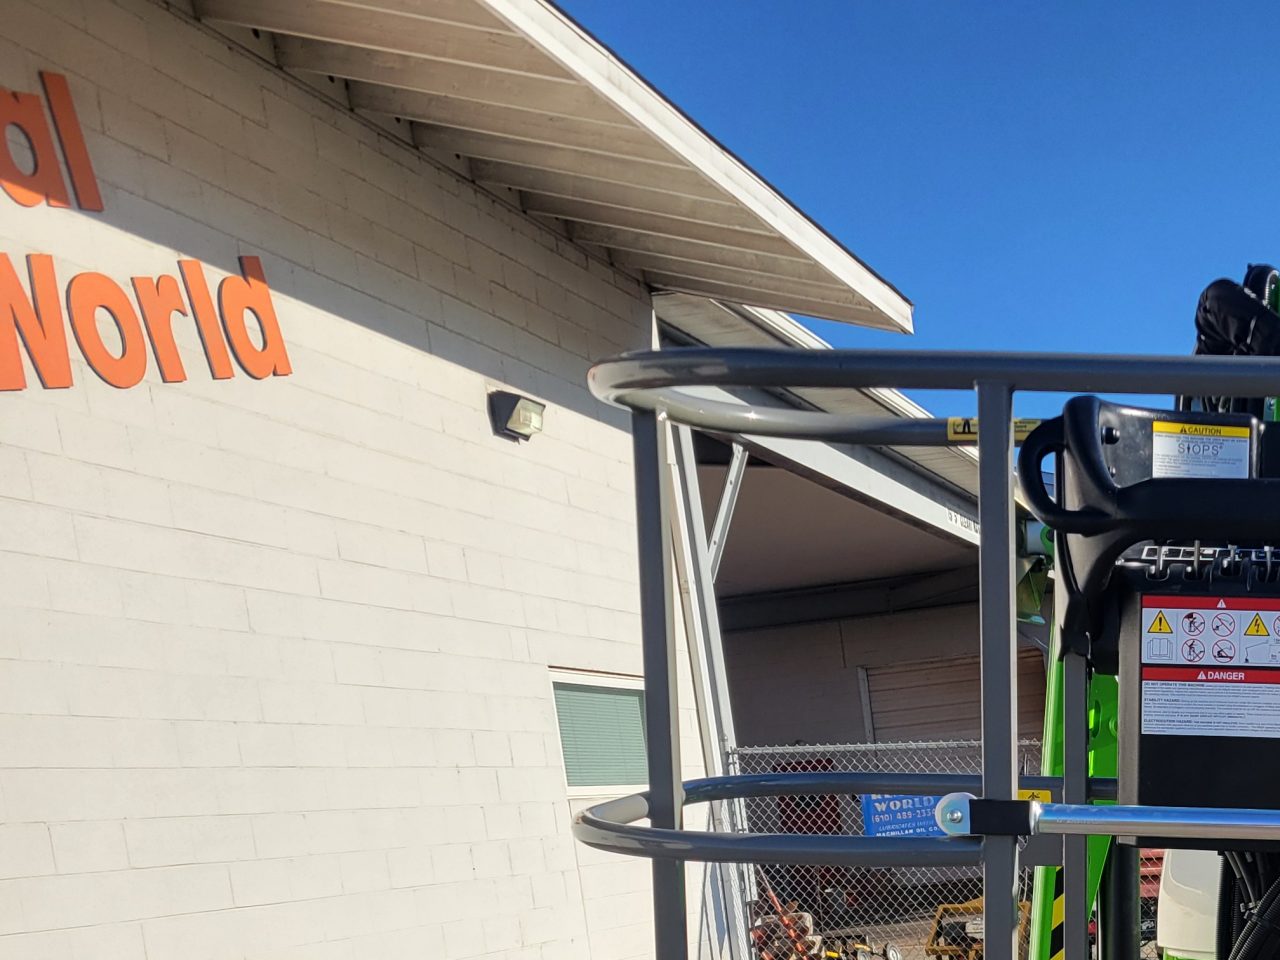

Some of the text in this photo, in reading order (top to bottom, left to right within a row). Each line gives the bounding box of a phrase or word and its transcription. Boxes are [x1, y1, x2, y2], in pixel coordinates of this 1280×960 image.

[1188, 426, 1222, 435] CAUTION
[1207, 671, 1245, 680] DANGER
[874, 796, 934, 812] WORLD
[871, 813, 893, 824] (610)
